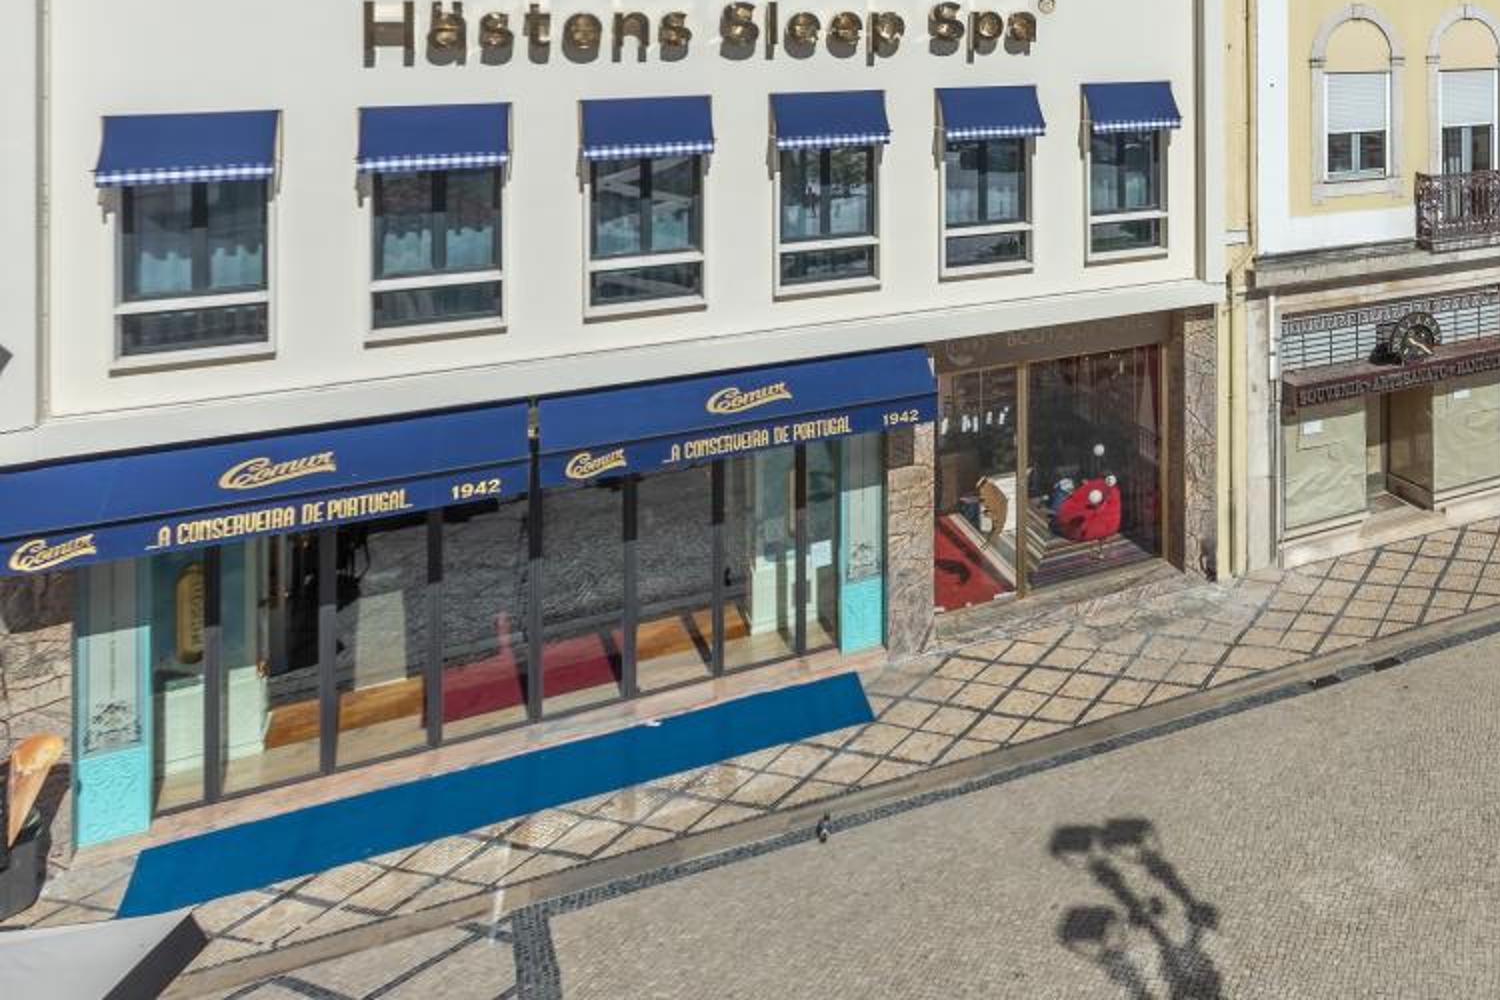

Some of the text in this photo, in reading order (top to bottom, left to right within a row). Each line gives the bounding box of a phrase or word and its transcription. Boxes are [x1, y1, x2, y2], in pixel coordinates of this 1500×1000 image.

[882, 409, 920, 426] 1942
[683, 429, 769, 459] CONSERVEIRA
[773, 424, 790, 444] DE
[793, 415, 853, 440] PORTUGAL
[451, 479, 502, 500] 1942
[176, 505, 296, 545] CONSERVEIRA
[301, 501, 325, 525] DE
